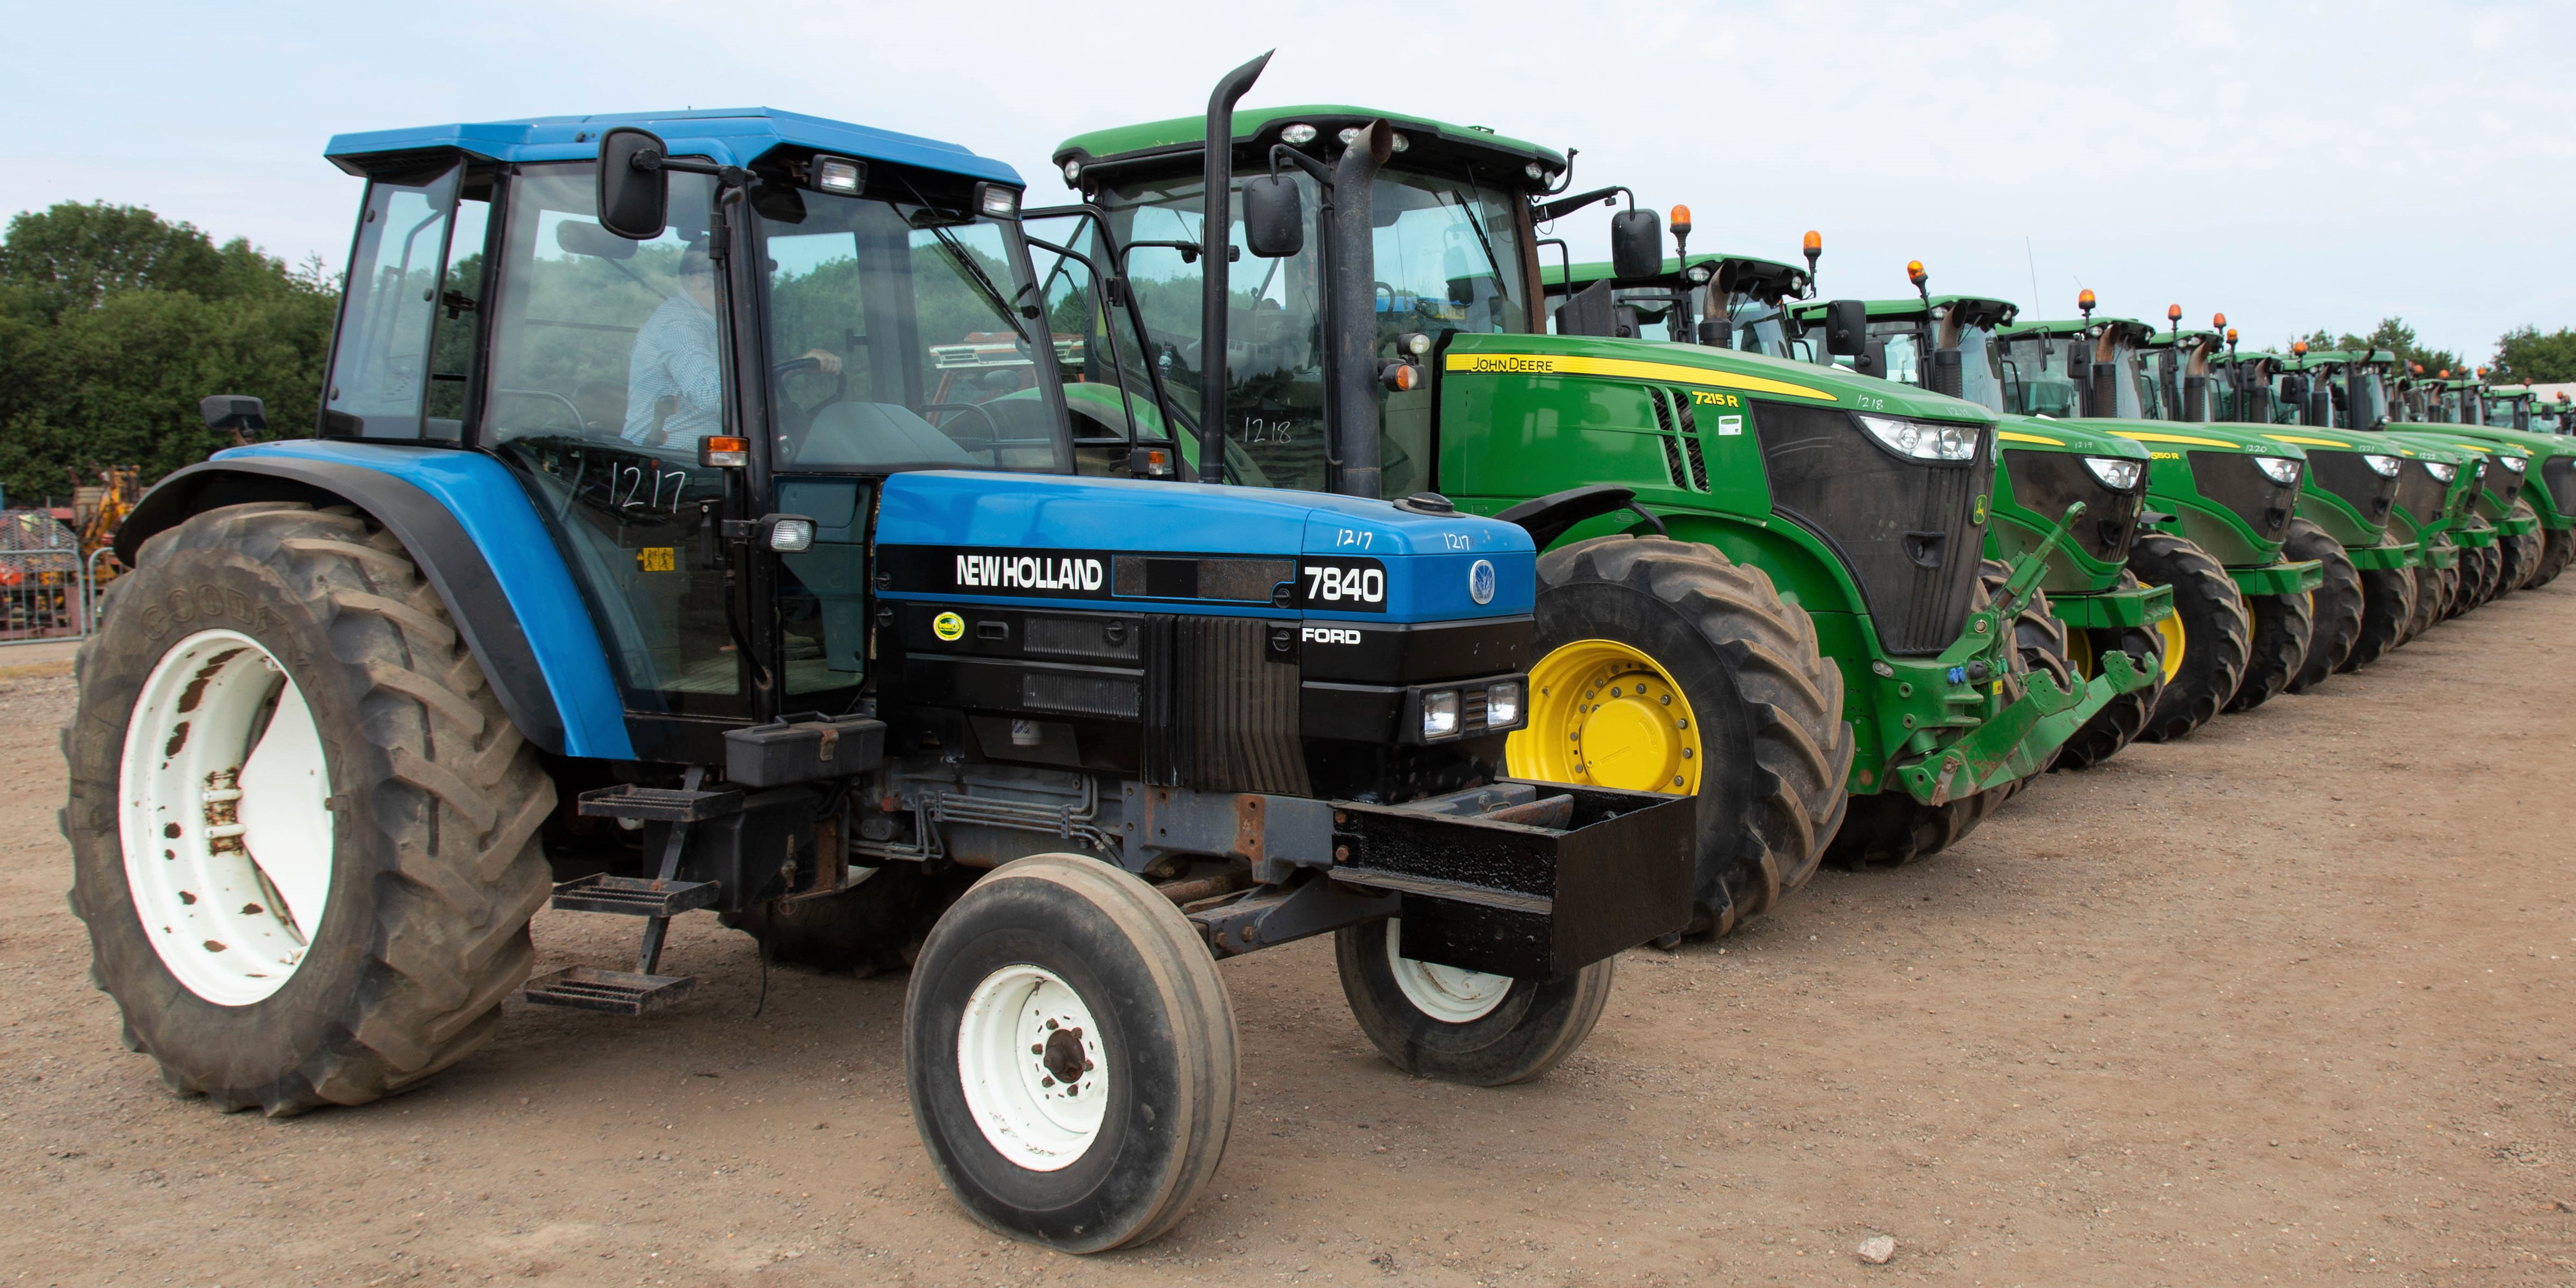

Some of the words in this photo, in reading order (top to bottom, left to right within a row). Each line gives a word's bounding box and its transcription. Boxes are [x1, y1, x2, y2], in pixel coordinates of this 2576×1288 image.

[1472, 357, 1507, 370] JOHN
[1509, 358, 1553, 371] DEERE
[1692, 391, 1725, 406] 7215
[1726, 395, 1739, 408] R
[1856, 394, 1884, 410] 1218
[1244, 417, 1291, 444] 1218
[2245, 444, 2268, 453] 1220
[609, 462, 686, 514] 1217
[1336, 528, 1373, 550] 1217
[1443, 532, 1470, 551] 1217
[957, 555, 1000, 587] NEW
[1003, 556, 1103, 591] HOLLAND
[1304, 566, 1384, 602] 7840
[1302, 628, 1361, 645] FORD
